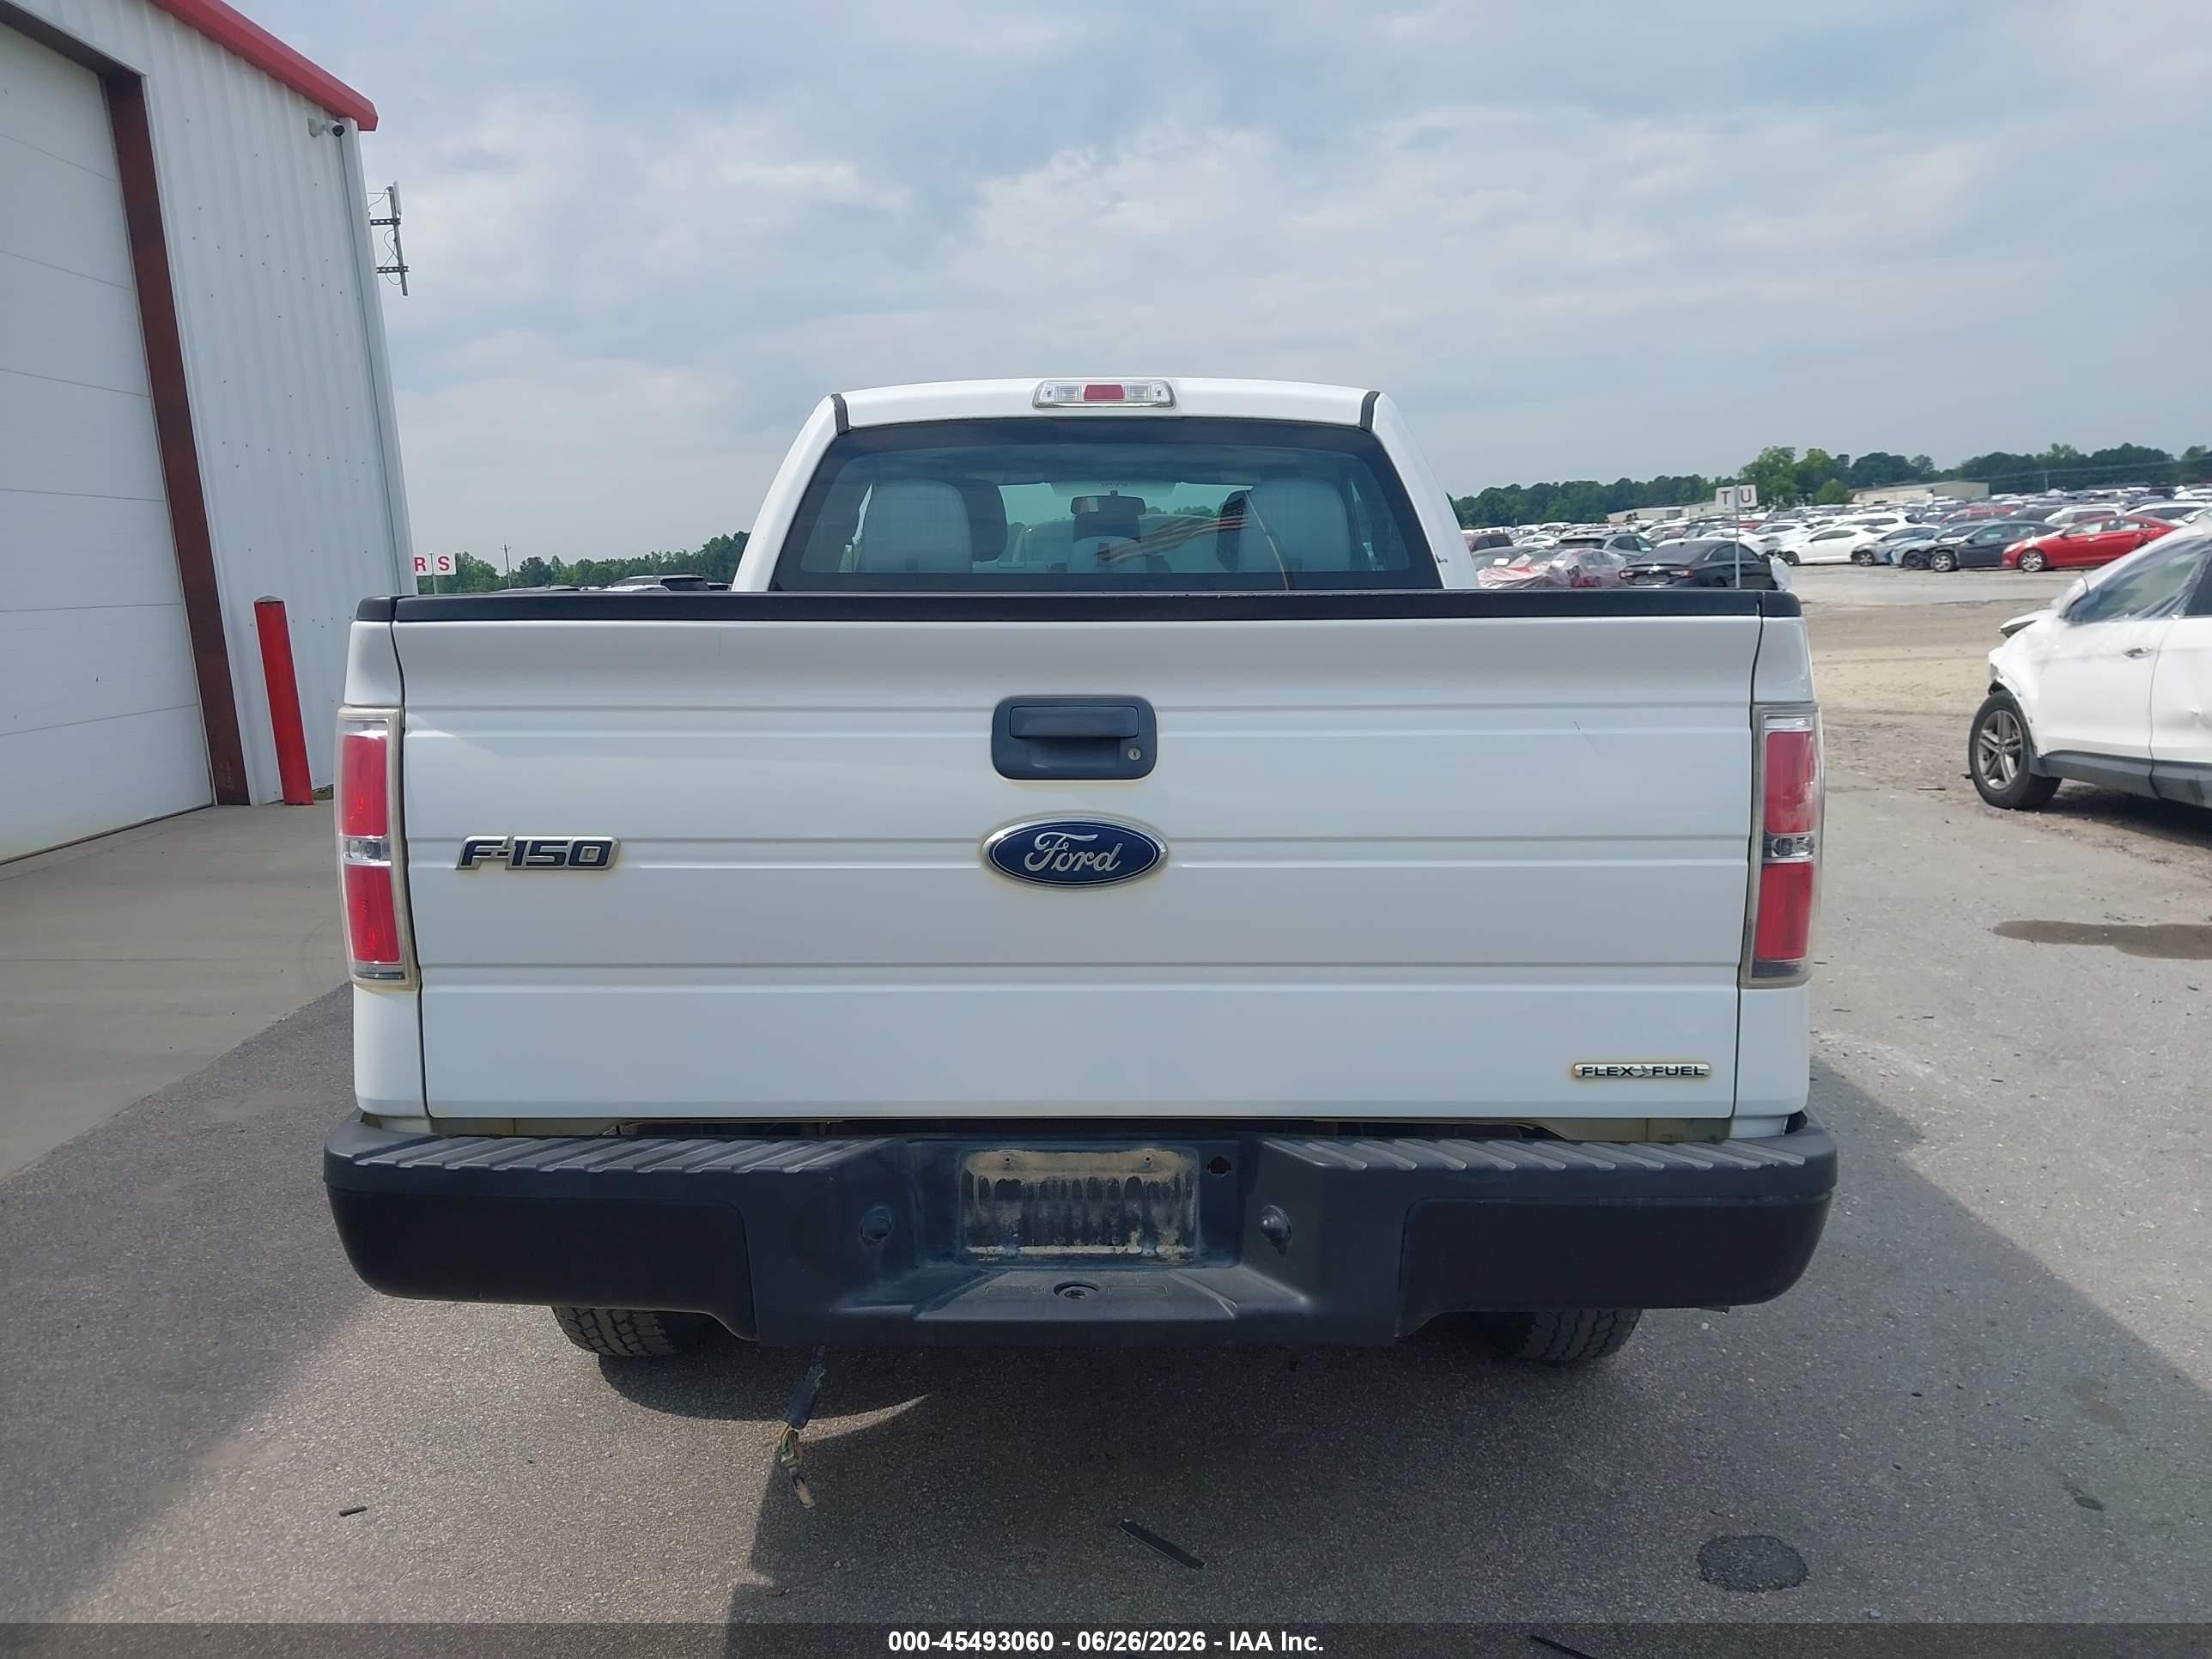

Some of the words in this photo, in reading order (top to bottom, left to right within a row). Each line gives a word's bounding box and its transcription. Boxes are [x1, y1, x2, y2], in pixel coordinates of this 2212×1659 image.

[1721, 490, 1731, 505] T
[1740, 489, 1752, 503] U
[414, 556, 426, 572] R
[438, 556, 450, 571] S
[457, 836, 620, 870] F-150
[1024, 832, 1123, 872] Ford
[1581, 1066, 1634, 1077] FLEX
[1651, 1066, 1705, 1076] FUEL
